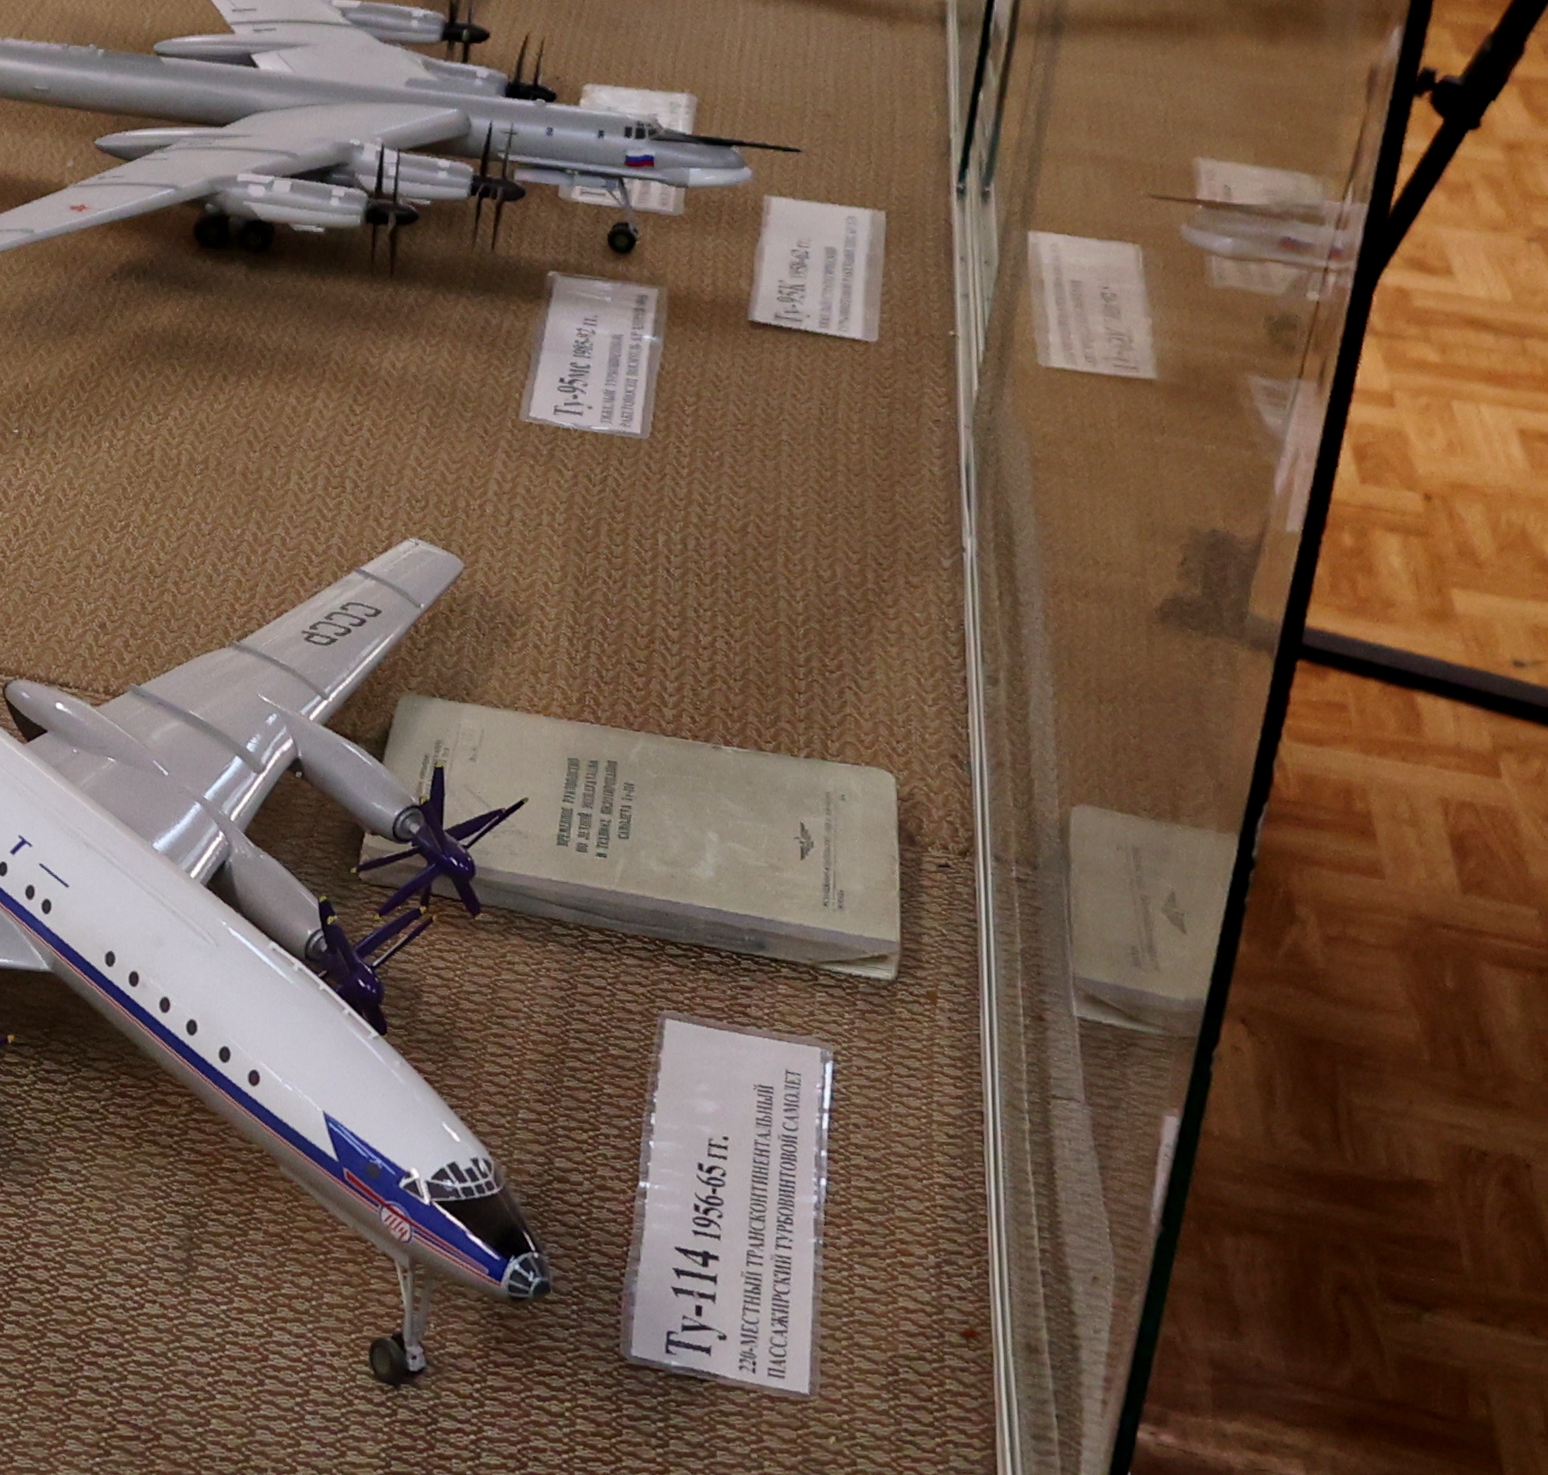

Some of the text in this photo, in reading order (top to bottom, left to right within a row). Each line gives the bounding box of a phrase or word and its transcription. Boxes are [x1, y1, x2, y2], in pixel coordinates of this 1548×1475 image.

[301, 601, 383, 647] СССР
[691, 1162, 727, 1243] 1956-65
[738, 1083, 775, 1375] 220-МЕСТНЫЙ ТРАНСКОНТИНЕНТАЛЬНЫЙ
[766, 1068, 803, 1380] ПАССАЖИРСКИЙ ТУРБОВИНТОВОЙ САМОЛЕТ
[664, 1244, 728, 1357] Ту-114
